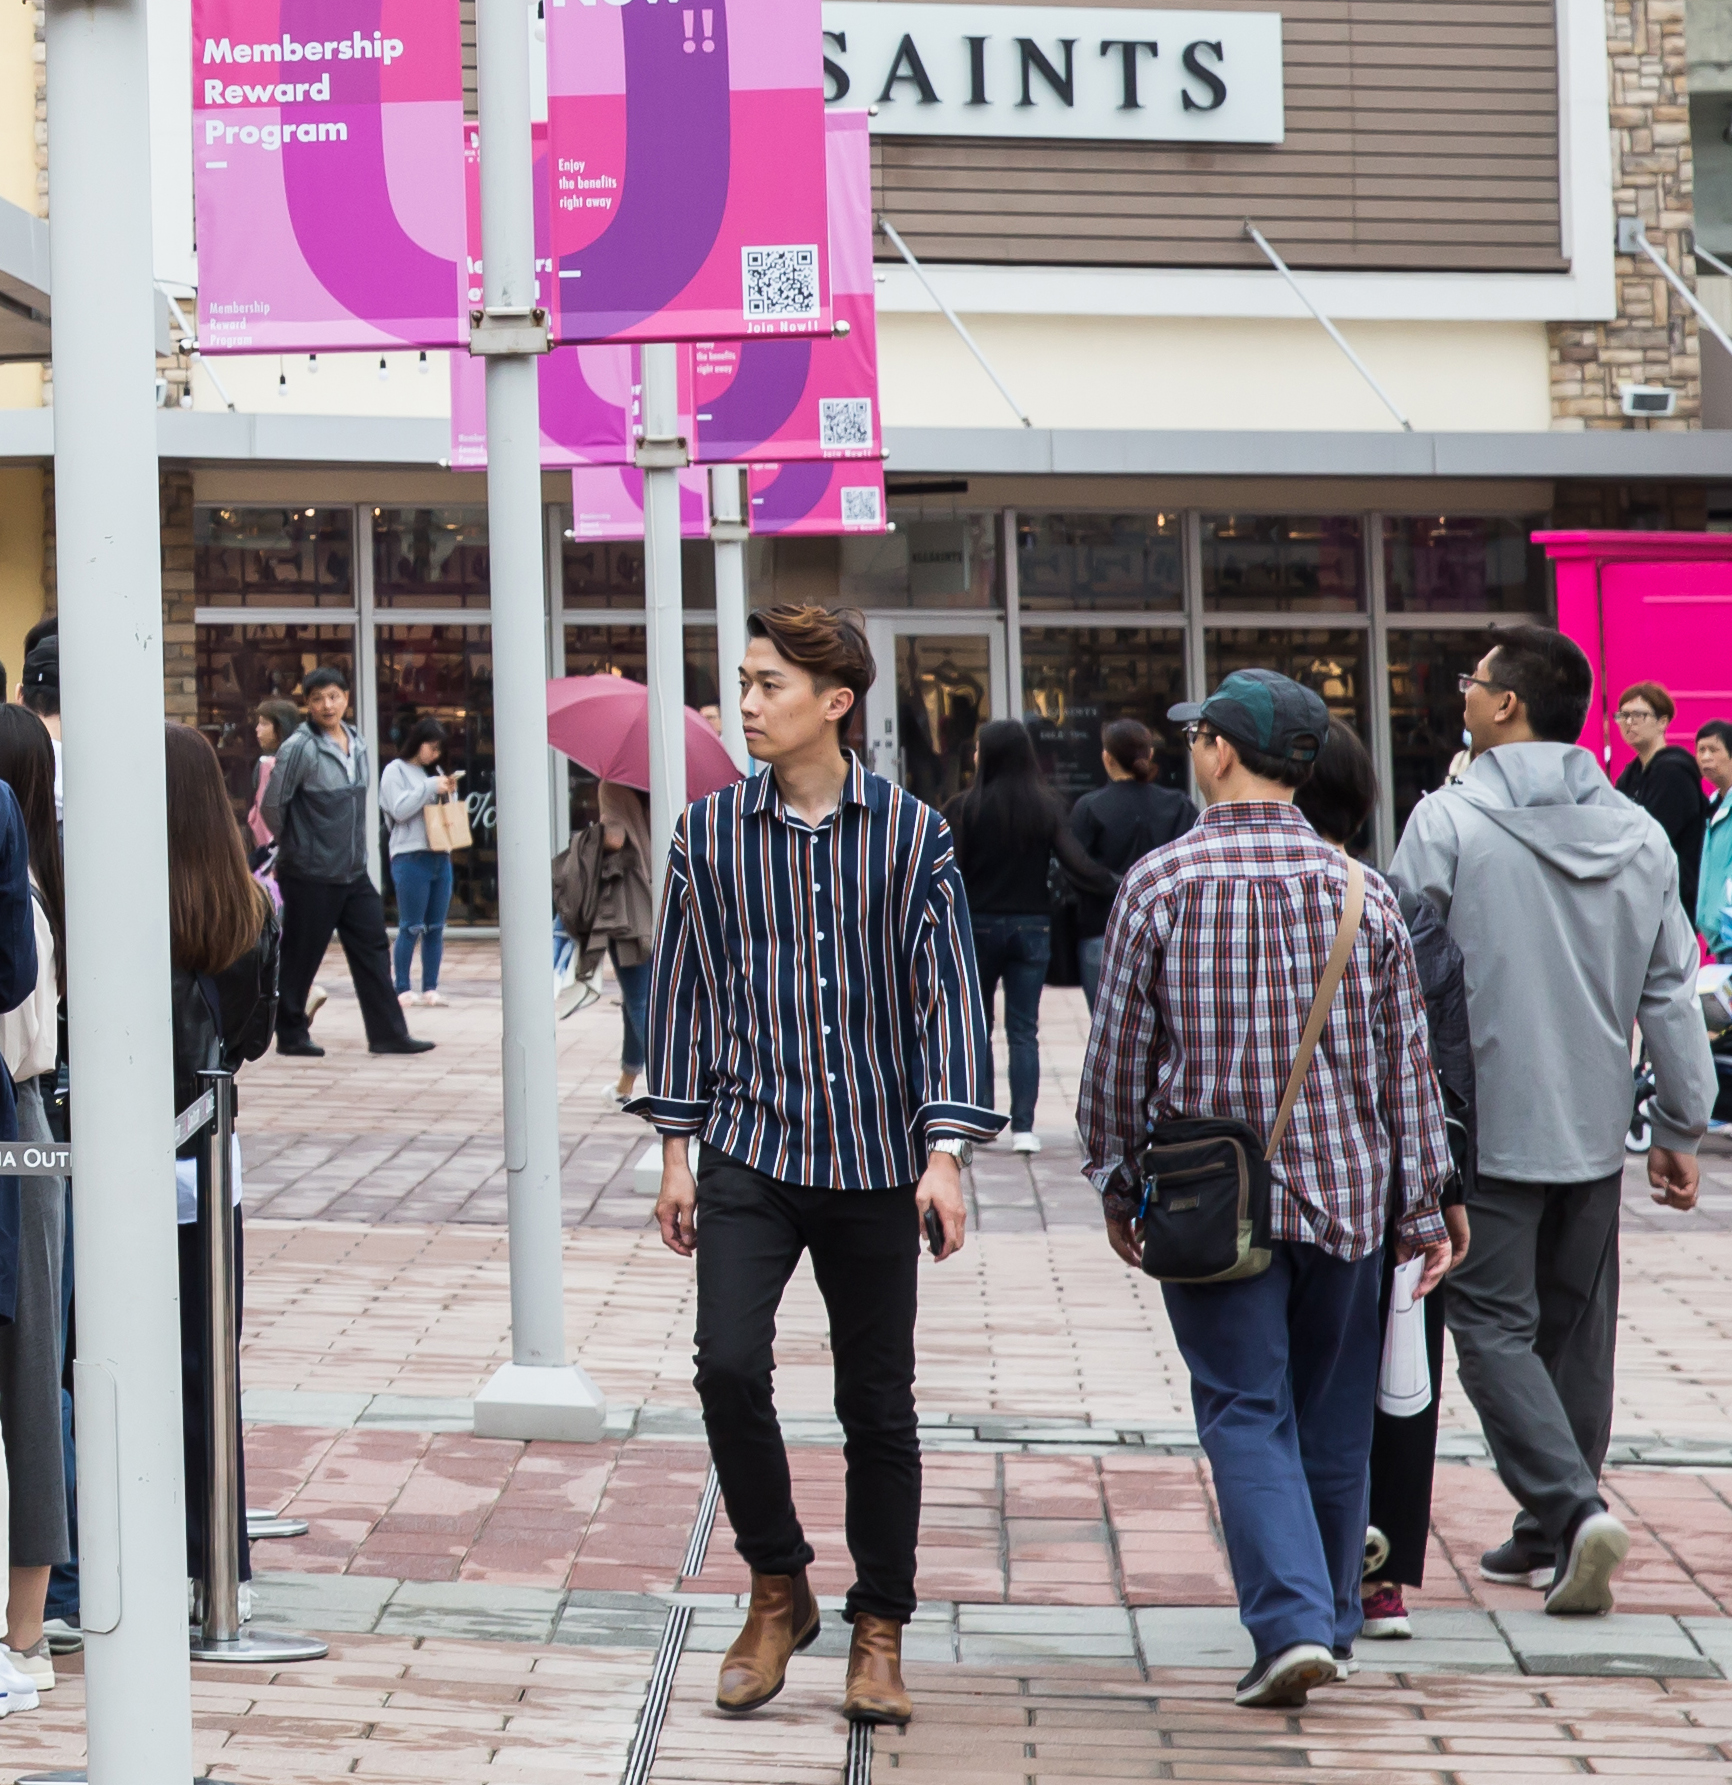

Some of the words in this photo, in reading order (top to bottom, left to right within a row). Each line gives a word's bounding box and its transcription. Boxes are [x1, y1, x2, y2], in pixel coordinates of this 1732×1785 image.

[202, 30, 404, 66] Membership
[204, 72, 331, 105] Reward
[205, 119, 348, 151] Program
[558, 158, 586, 174] Enjoy
[558, 175, 575, 190] the
[577, 174, 617, 190] benefits
[559, 194, 583, 211] right
[585, 197, 612, 210] away
[209, 300, 271, 316] Membership
[746, 321, 774, 334] Join
[210, 334, 253, 348] Program
[23, 1147, 72, 1168] OUT
